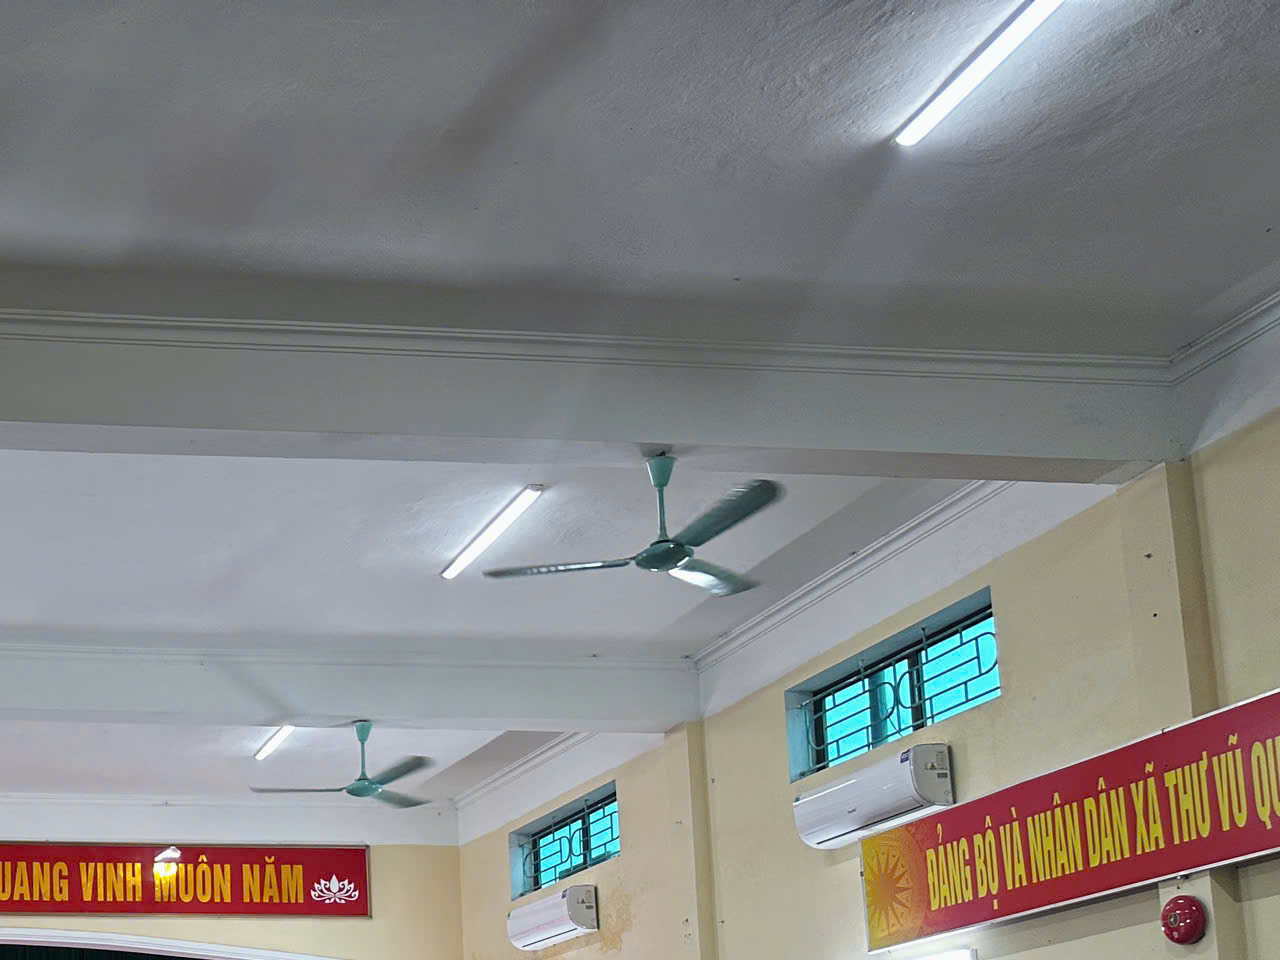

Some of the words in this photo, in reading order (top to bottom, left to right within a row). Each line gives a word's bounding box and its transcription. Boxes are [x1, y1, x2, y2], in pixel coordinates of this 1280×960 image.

[79, 862, 142, 902] VINH
[153, 854, 231, 903] MUÔN
[242, 856, 304, 904] NĂM
[926, 823, 973, 911] ĐẢNG
[973, 816, 999, 910] BỘ
[999, 807, 1027, 891] VÀ
[1026, 792, 1084, 884] NHÂN
[1084, 777, 1129, 868] DÂN
[1130, 761, 1165, 856] XÃ
[1164, 751, 1211, 845] THƯ
[1212, 733, 1247, 831] VŨ
